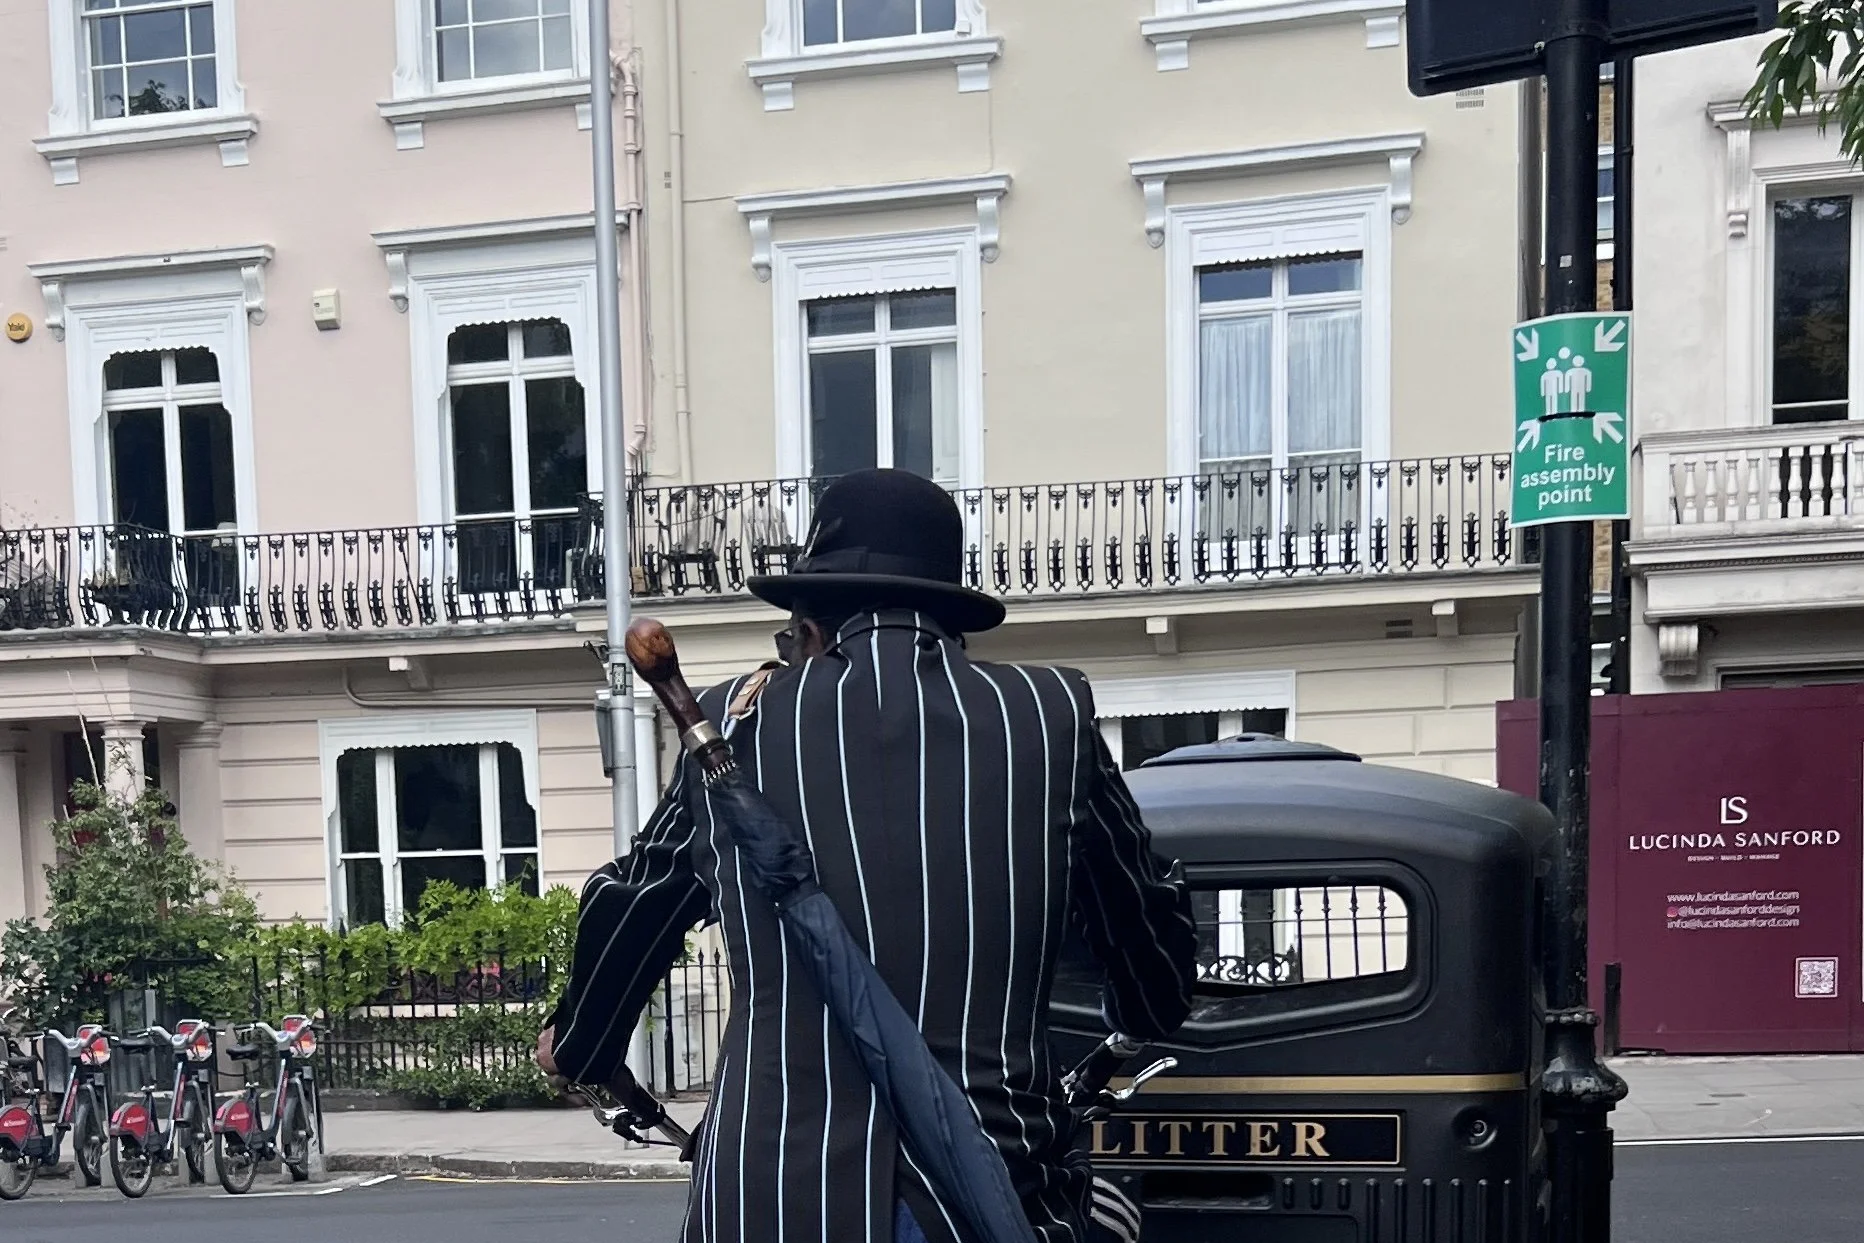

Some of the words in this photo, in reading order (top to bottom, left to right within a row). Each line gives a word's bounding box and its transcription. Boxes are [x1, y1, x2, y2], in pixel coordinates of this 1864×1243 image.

[1544, 443, 1585, 464] Fire
[1520, 462, 1616, 488] assembly
[1538, 484, 1592, 511] point
[1720, 796, 1749, 824] LS
[1629, 833, 1726, 850] LUCINDA
[1734, 830, 1841, 848] SANFORD
[1091, 1120, 1330, 1157] LITTER
